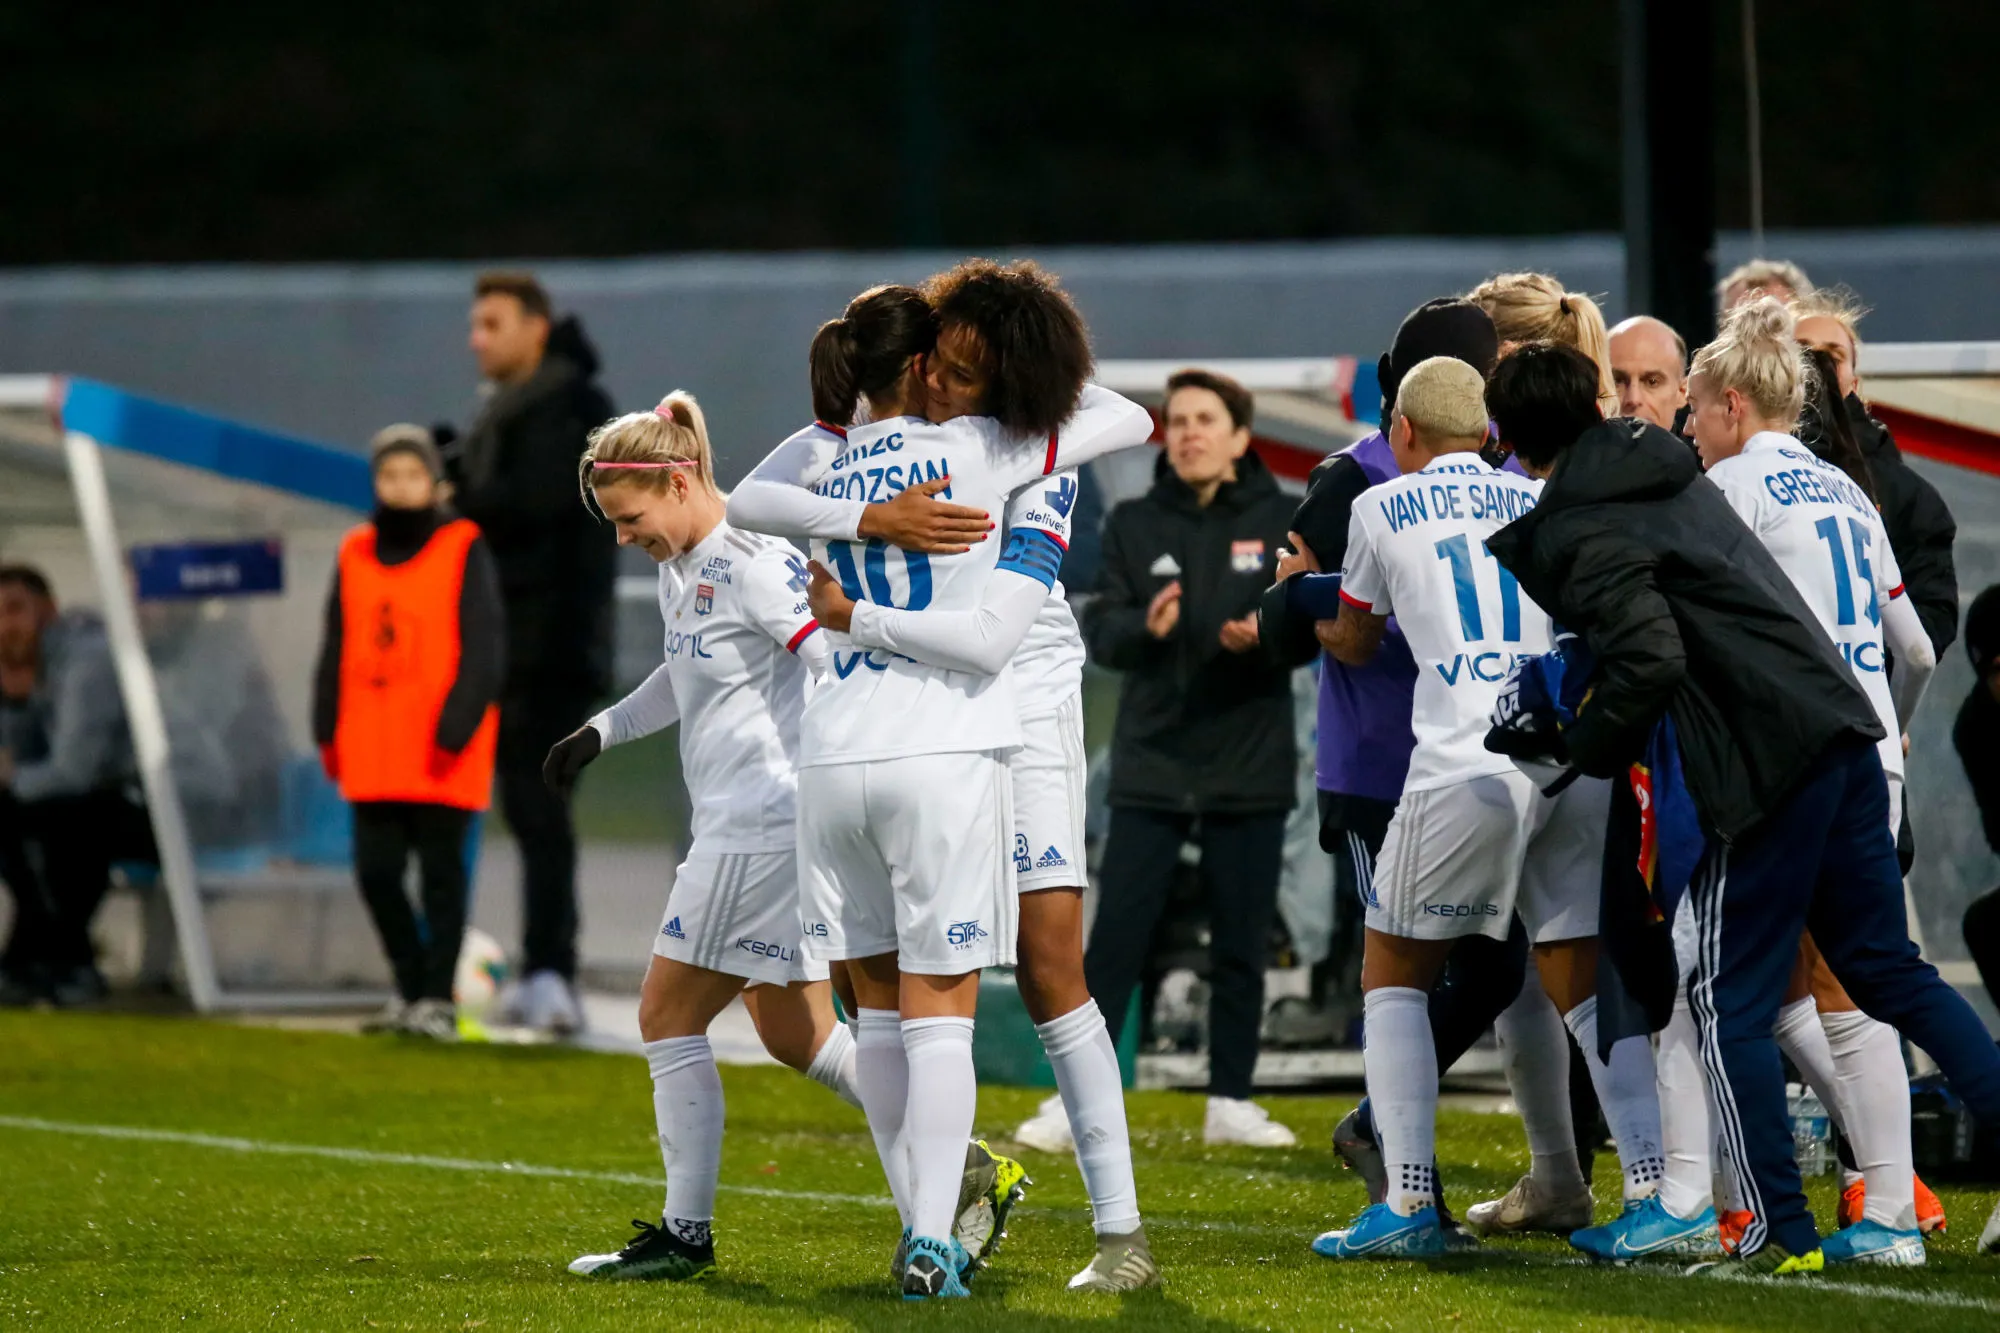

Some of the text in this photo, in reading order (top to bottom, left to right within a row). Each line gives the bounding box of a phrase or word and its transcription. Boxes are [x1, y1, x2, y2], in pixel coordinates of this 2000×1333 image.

[1380, 487, 1429, 533] VAN
[1430, 484, 1464, 519] DE
[701, 567, 732, 585] MERLIN
[708, 556, 733, 571] LEROY
[826, 538, 933, 611] 10
[1814, 515, 1882, 628] 15
[1436, 652, 1540, 687] VIC
[1036, 859, 1067, 868] adidas
